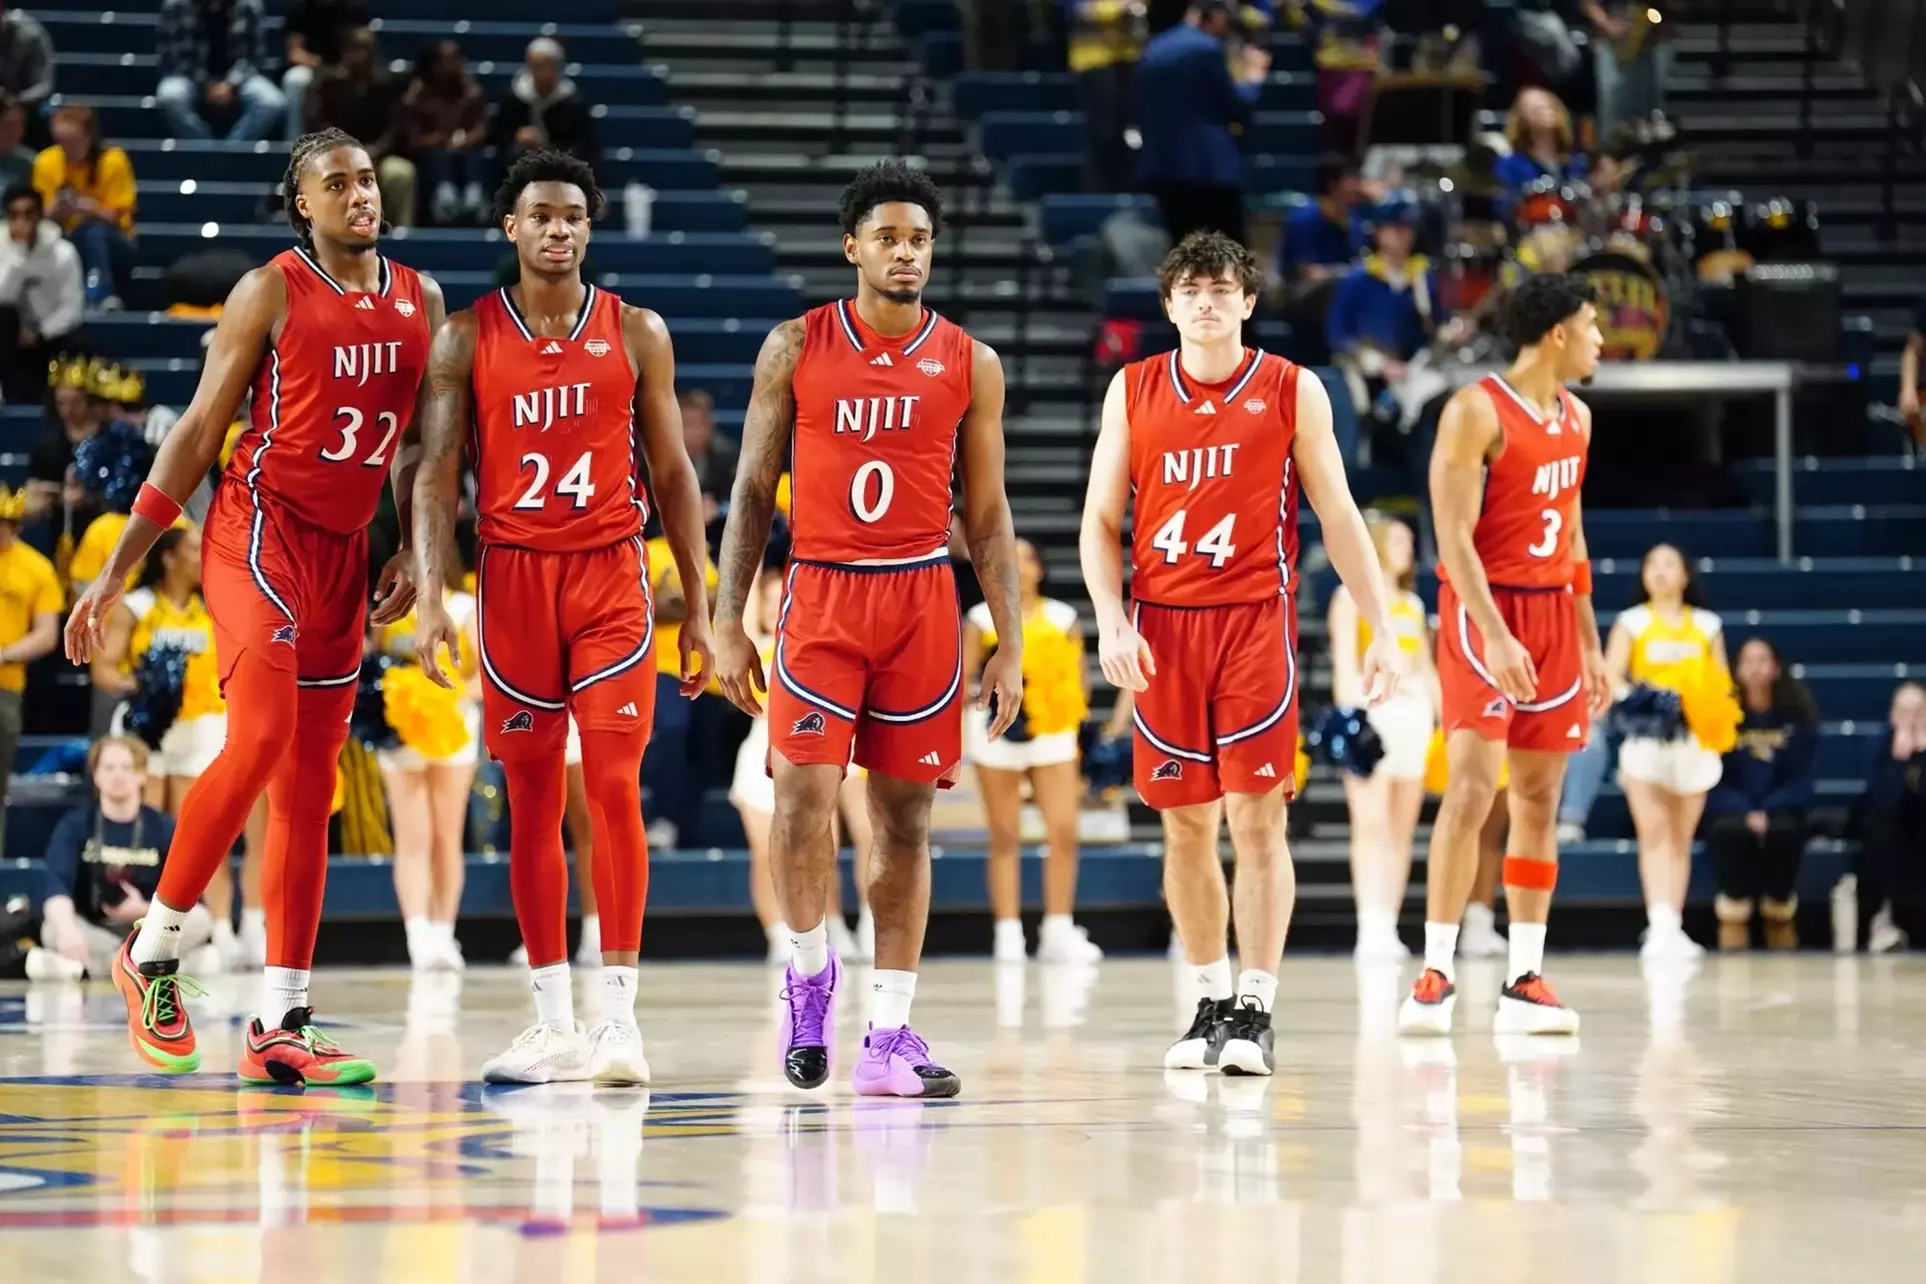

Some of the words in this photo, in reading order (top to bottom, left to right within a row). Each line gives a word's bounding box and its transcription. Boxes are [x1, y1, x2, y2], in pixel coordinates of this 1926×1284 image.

[334, 341, 402, 387] NJIT
[513, 382, 592, 433] NJIT
[835, 396, 920, 442] NJIT
[318, 406, 398, 468] 32
[512, 451, 596, 511] 24
[849, 460, 895, 524] 0
[1163, 443, 1240, 492] NJIT
[1532, 455, 1580, 500] NJIT
[1152, 509, 1236, 569] 44
[1528, 508, 1562, 558] 3
